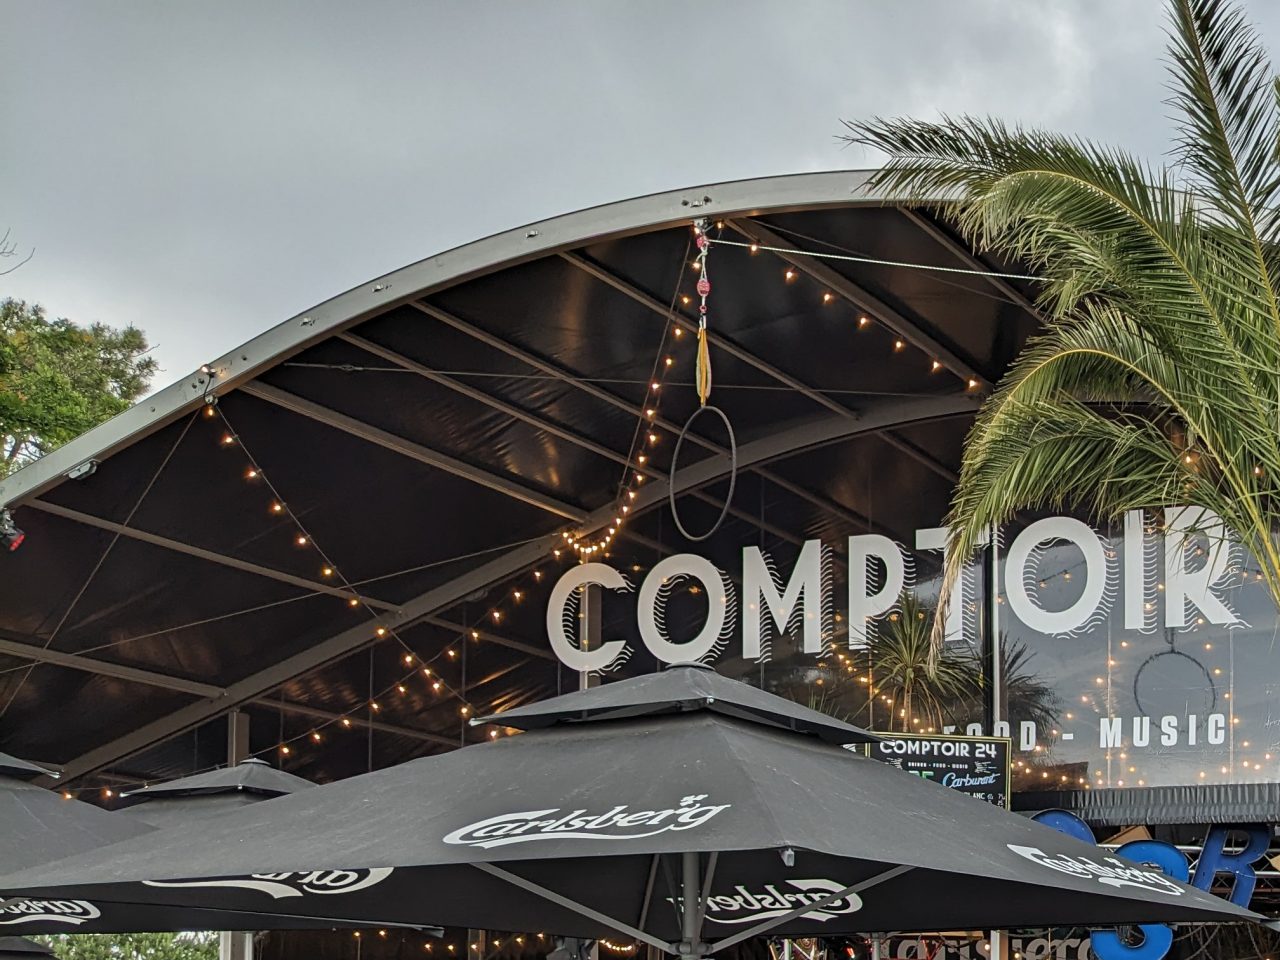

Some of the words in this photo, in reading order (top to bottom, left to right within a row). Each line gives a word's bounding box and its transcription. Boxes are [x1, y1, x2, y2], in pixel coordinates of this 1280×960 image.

[546, 505, 1240, 674] COMPTOIR
[879, 740, 970, 758] COMPTOIR
[974, 743, 997, 759] 24
[1100, 713, 1225, 750] MUSIC
[443, 798, 731, 848] Carlsberg
